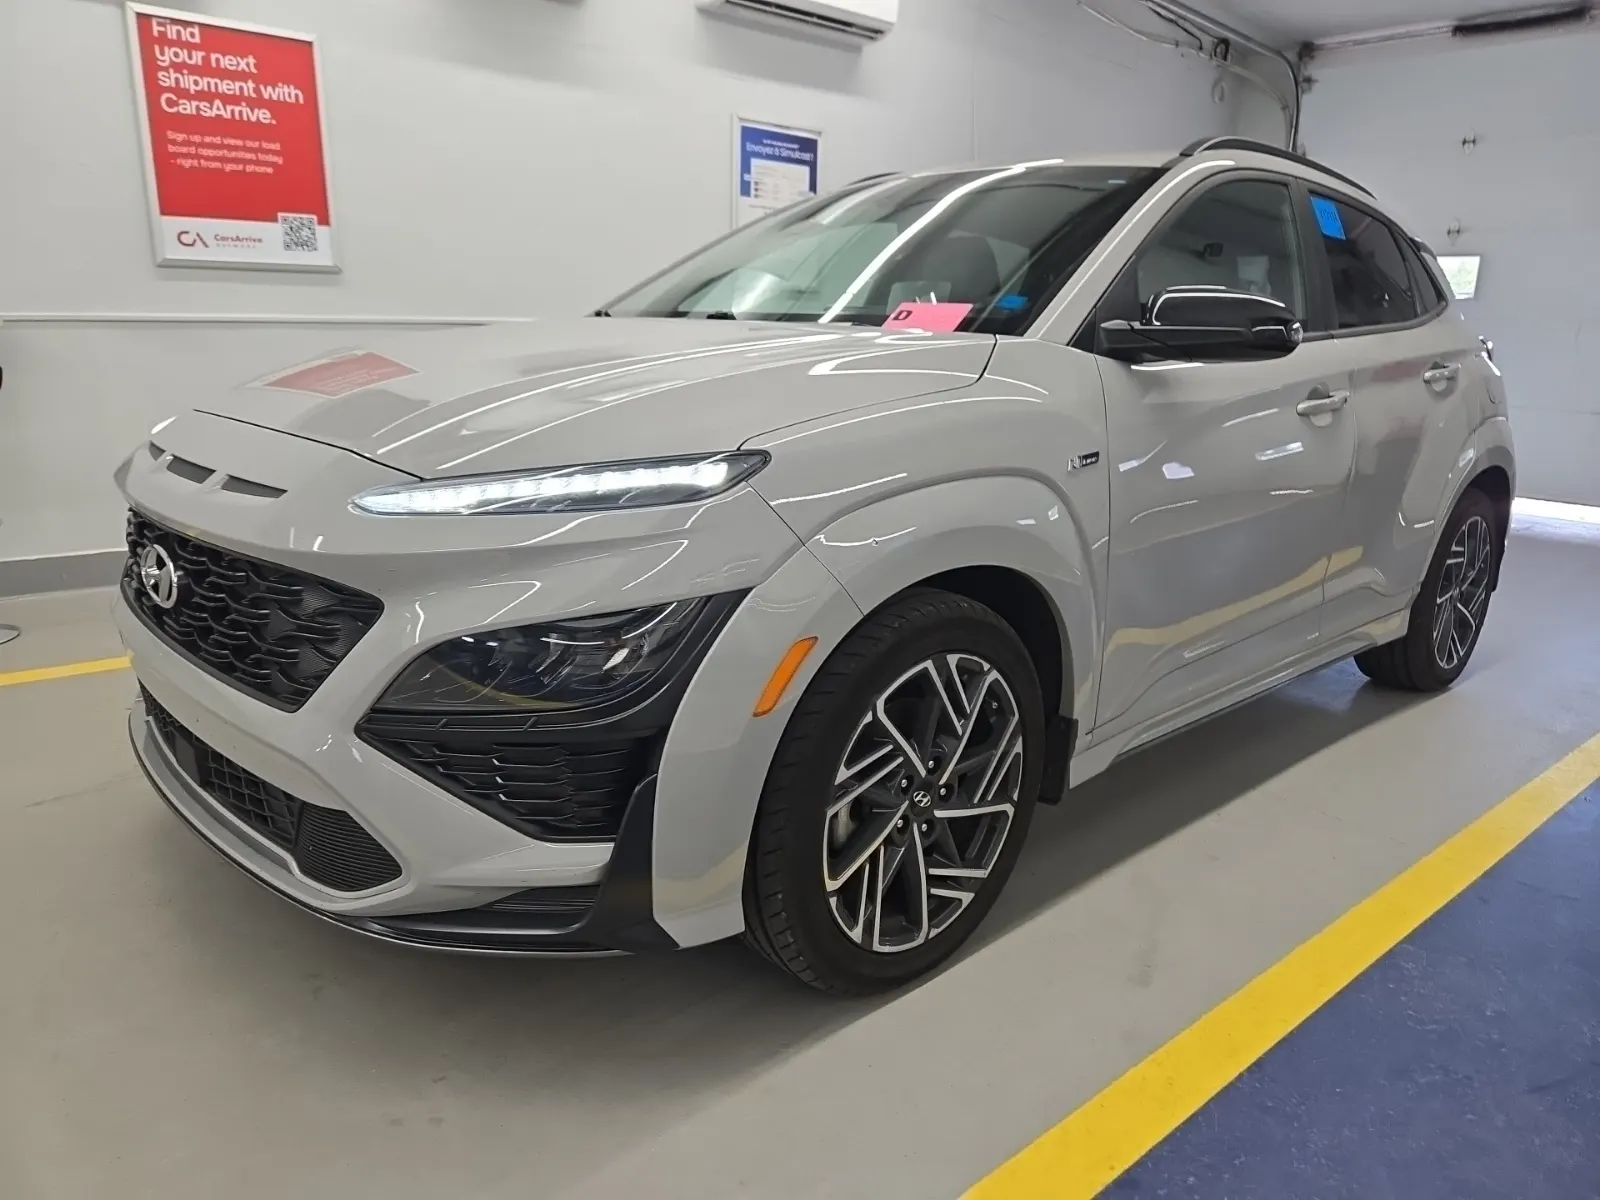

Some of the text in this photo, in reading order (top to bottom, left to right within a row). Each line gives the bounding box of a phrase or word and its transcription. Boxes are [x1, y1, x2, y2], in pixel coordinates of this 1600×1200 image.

[152, 17, 200, 43] Find
[154, 44, 257, 73] your next
[157, 68, 304, 104] shipment with
[160, 93, 276, 124] CarsArrive.
[166, 130, 281, 150] Sign up and view our load
[167, 143, 283, 164] board opportunities today
[176, 157, 199, 168] right
[200, 159, 222, 168] from
[223, 163, 244, 172] your
[245, 163, 274, 174] phone
[214, 234, 264, 243] CarsArrive
[892, 310, 913, 321] D
